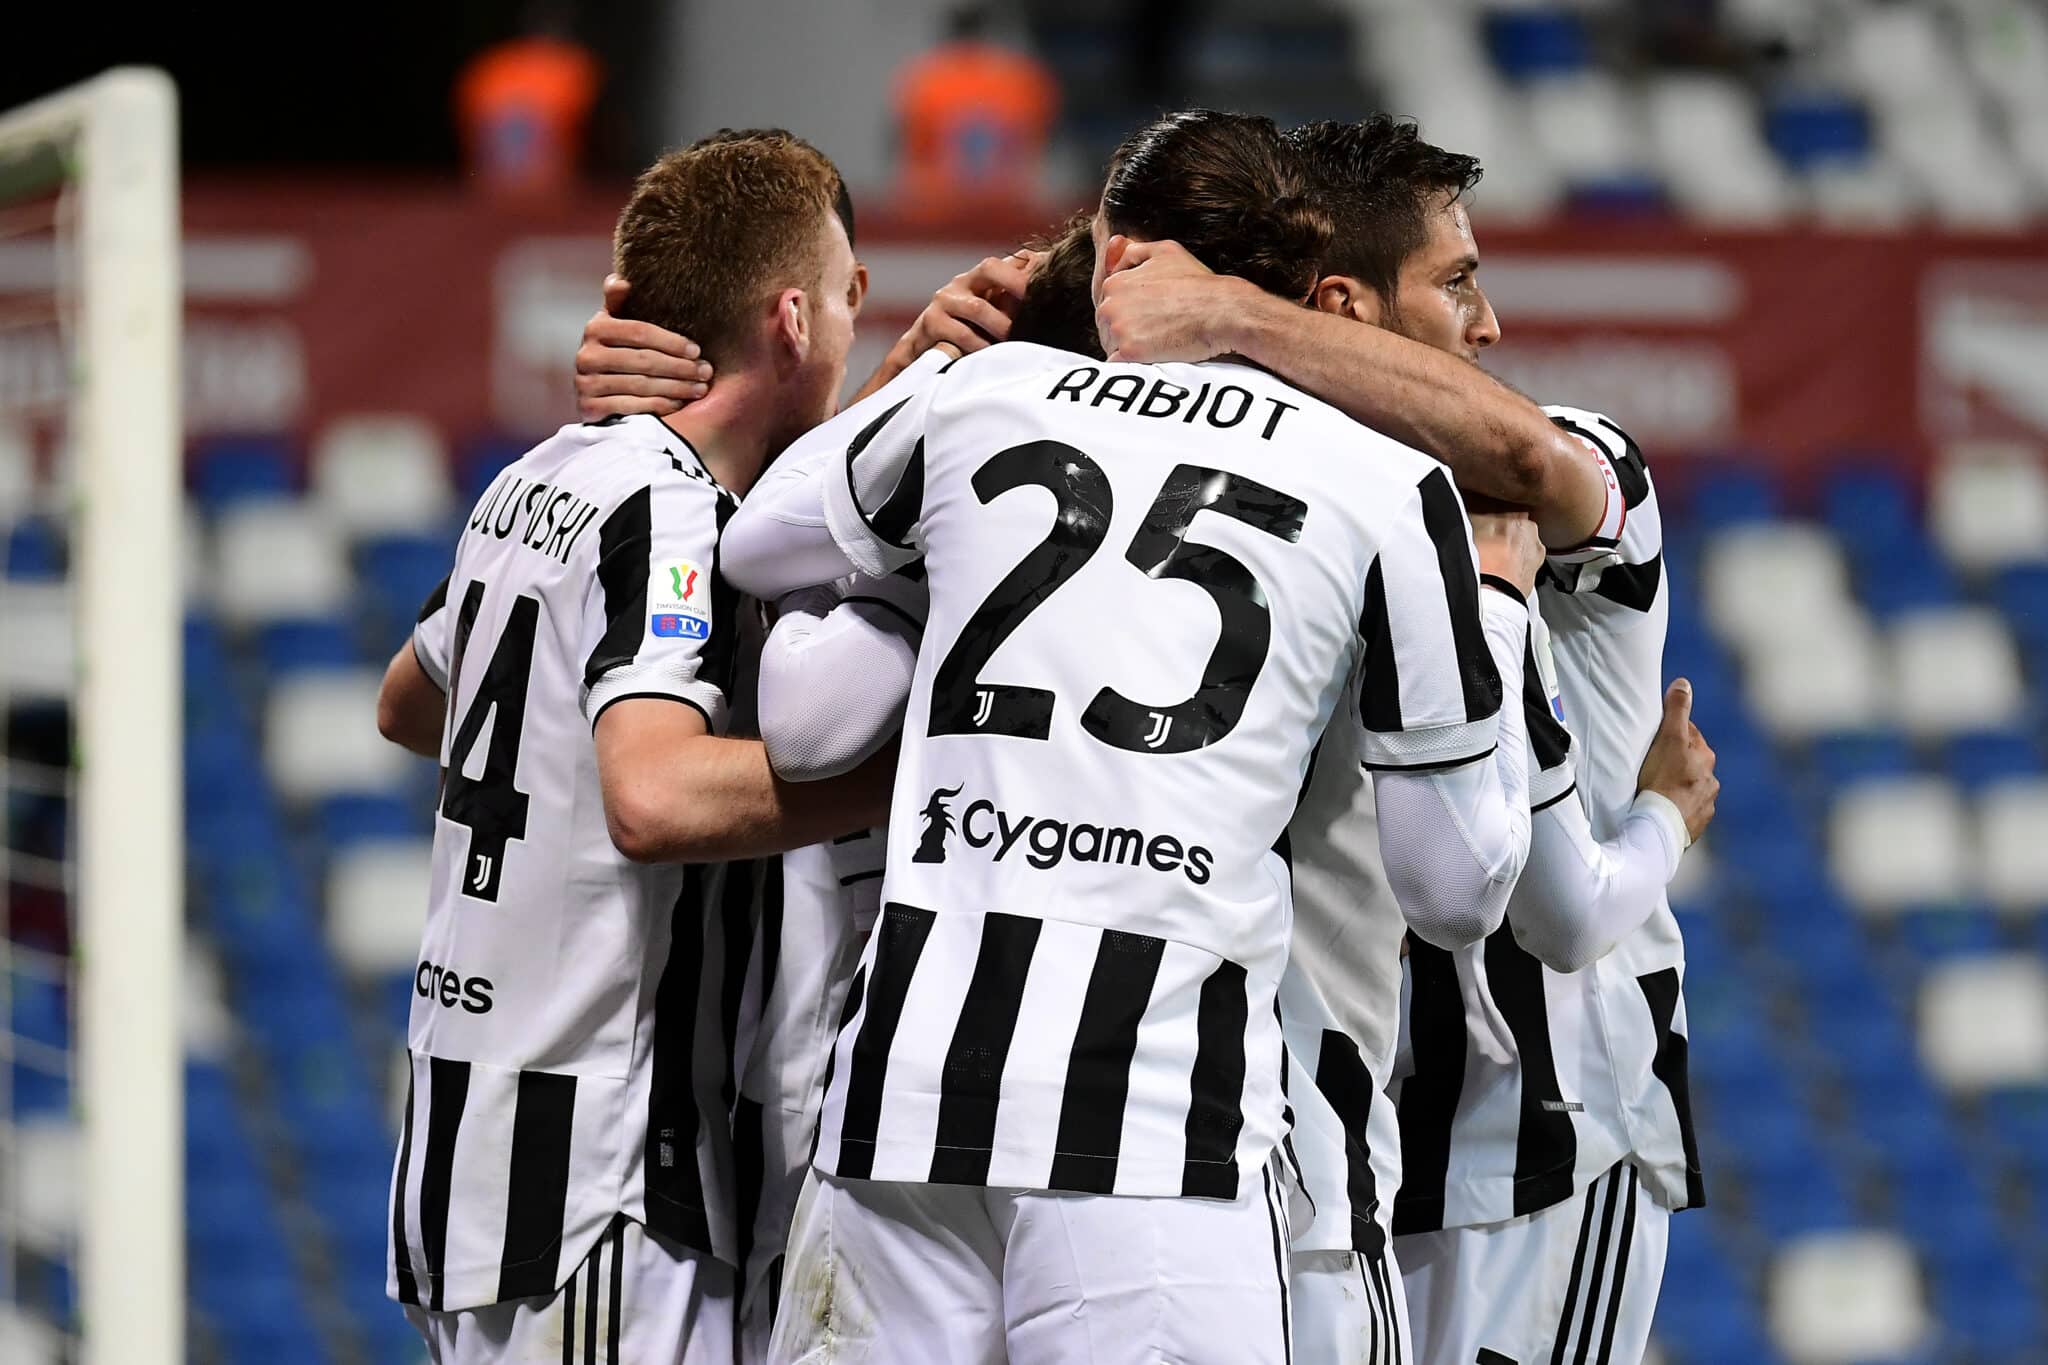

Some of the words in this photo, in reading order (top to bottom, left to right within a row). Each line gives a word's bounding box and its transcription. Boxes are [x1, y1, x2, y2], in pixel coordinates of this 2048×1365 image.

[1046, 367, 1300, 441] RABIOT
[679, 617, 702, 633] TV
[927, 440, 1308, 754] 25
[962, 798, 1215, 886] Cygames
